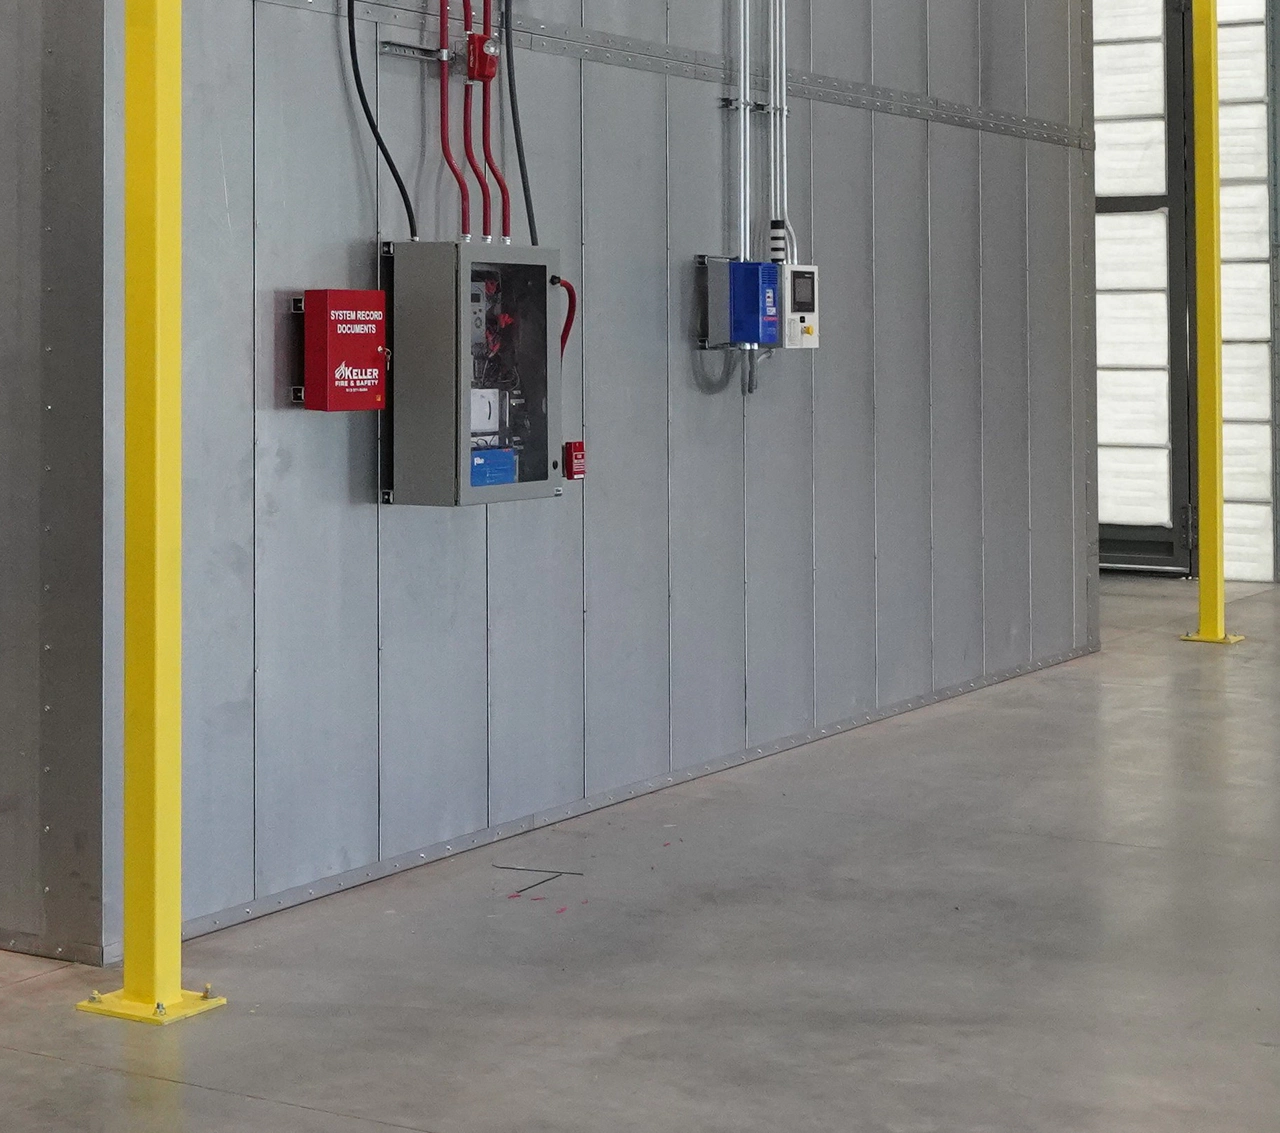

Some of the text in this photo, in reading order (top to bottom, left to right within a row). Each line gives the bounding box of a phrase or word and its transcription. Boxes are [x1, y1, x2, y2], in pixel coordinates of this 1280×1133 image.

[330, 310, 383, 320] SYSTEM RECORD
[337, 324, 376, 334] DOCUMENTS
[345, 367, 379, 379] KELLER
